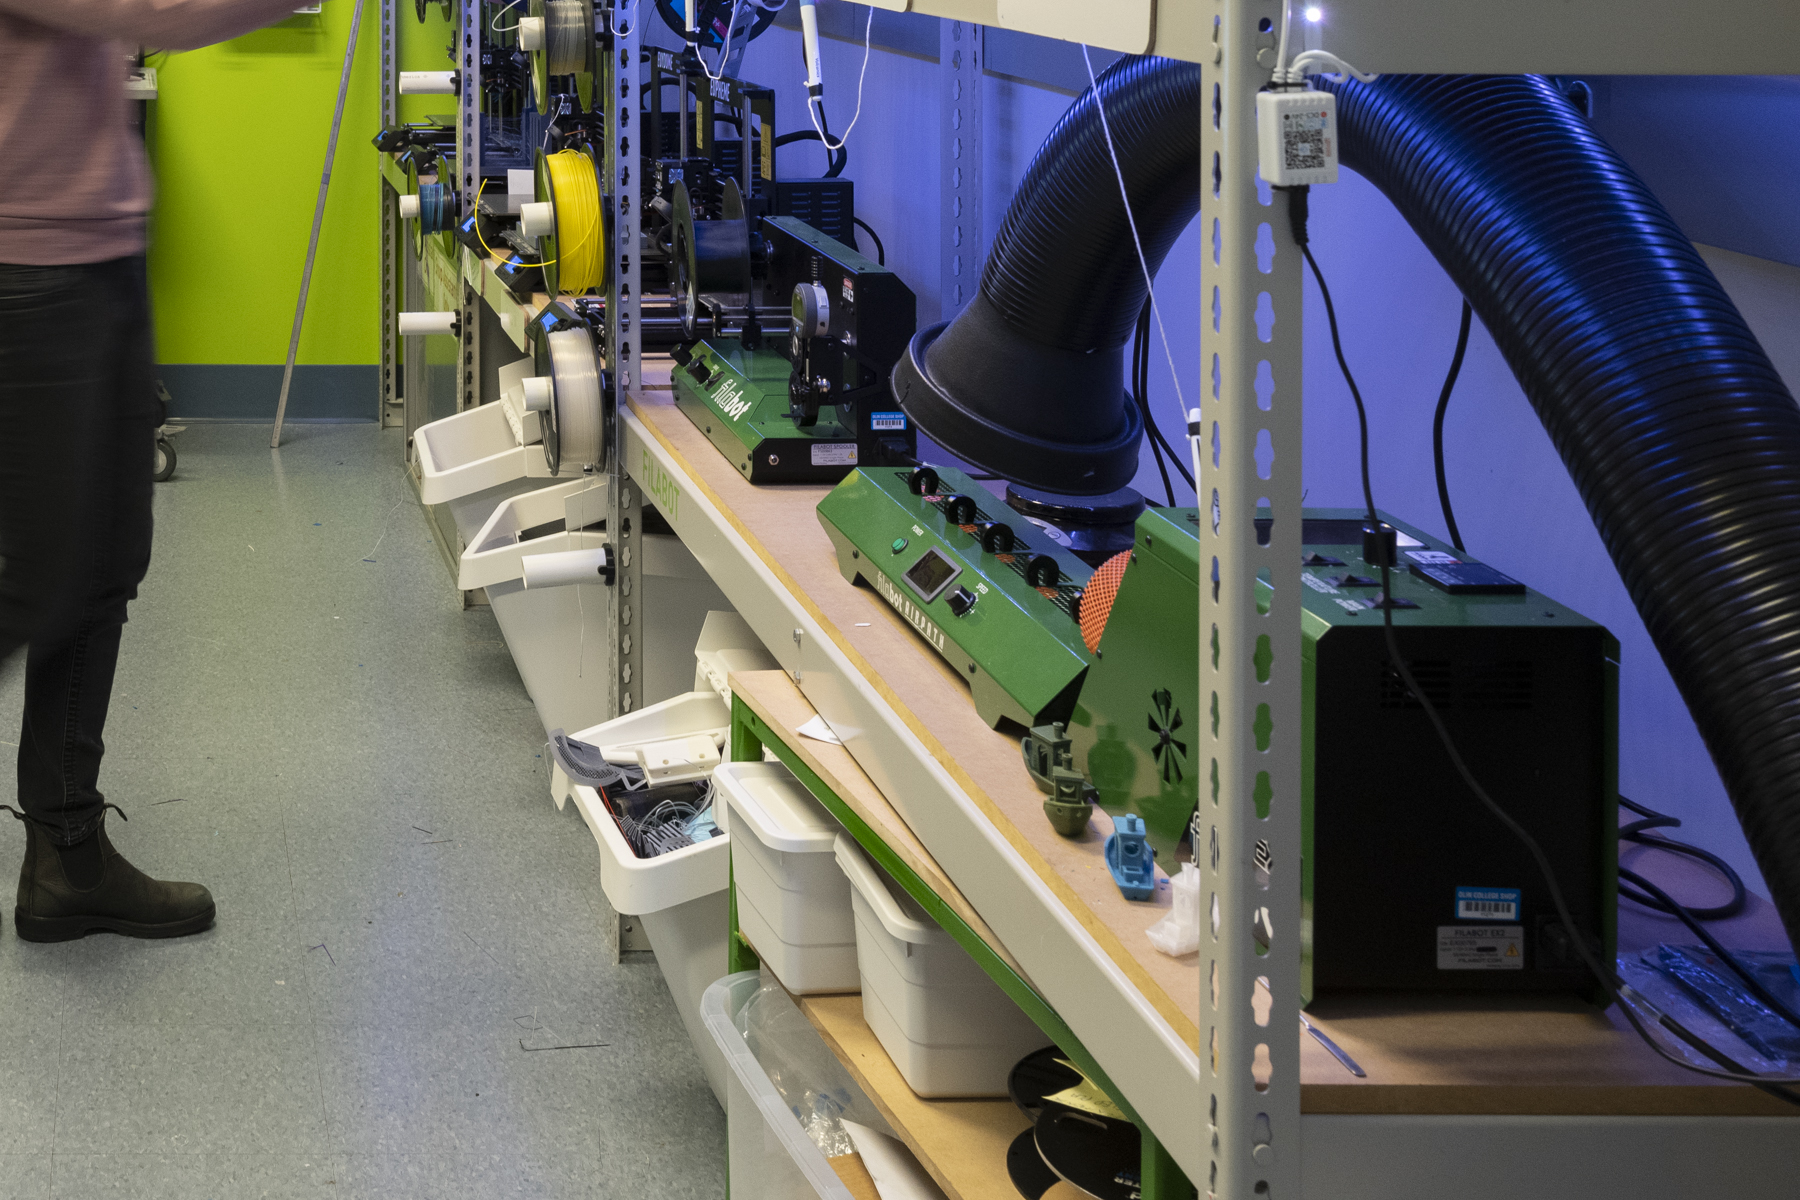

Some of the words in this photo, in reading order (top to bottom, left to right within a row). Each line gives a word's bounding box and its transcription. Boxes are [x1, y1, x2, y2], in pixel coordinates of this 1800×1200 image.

[711, 379, 752, 421] filabot
[643, 449, 680, 521] FILABOT
[877, 571, 903, 611] filabot
[1473, 891, 1499, 899] COLLEGE
[1500, 892, 1517, 900] SHOP
[1454, 929, 1488, 937] FILABOT
